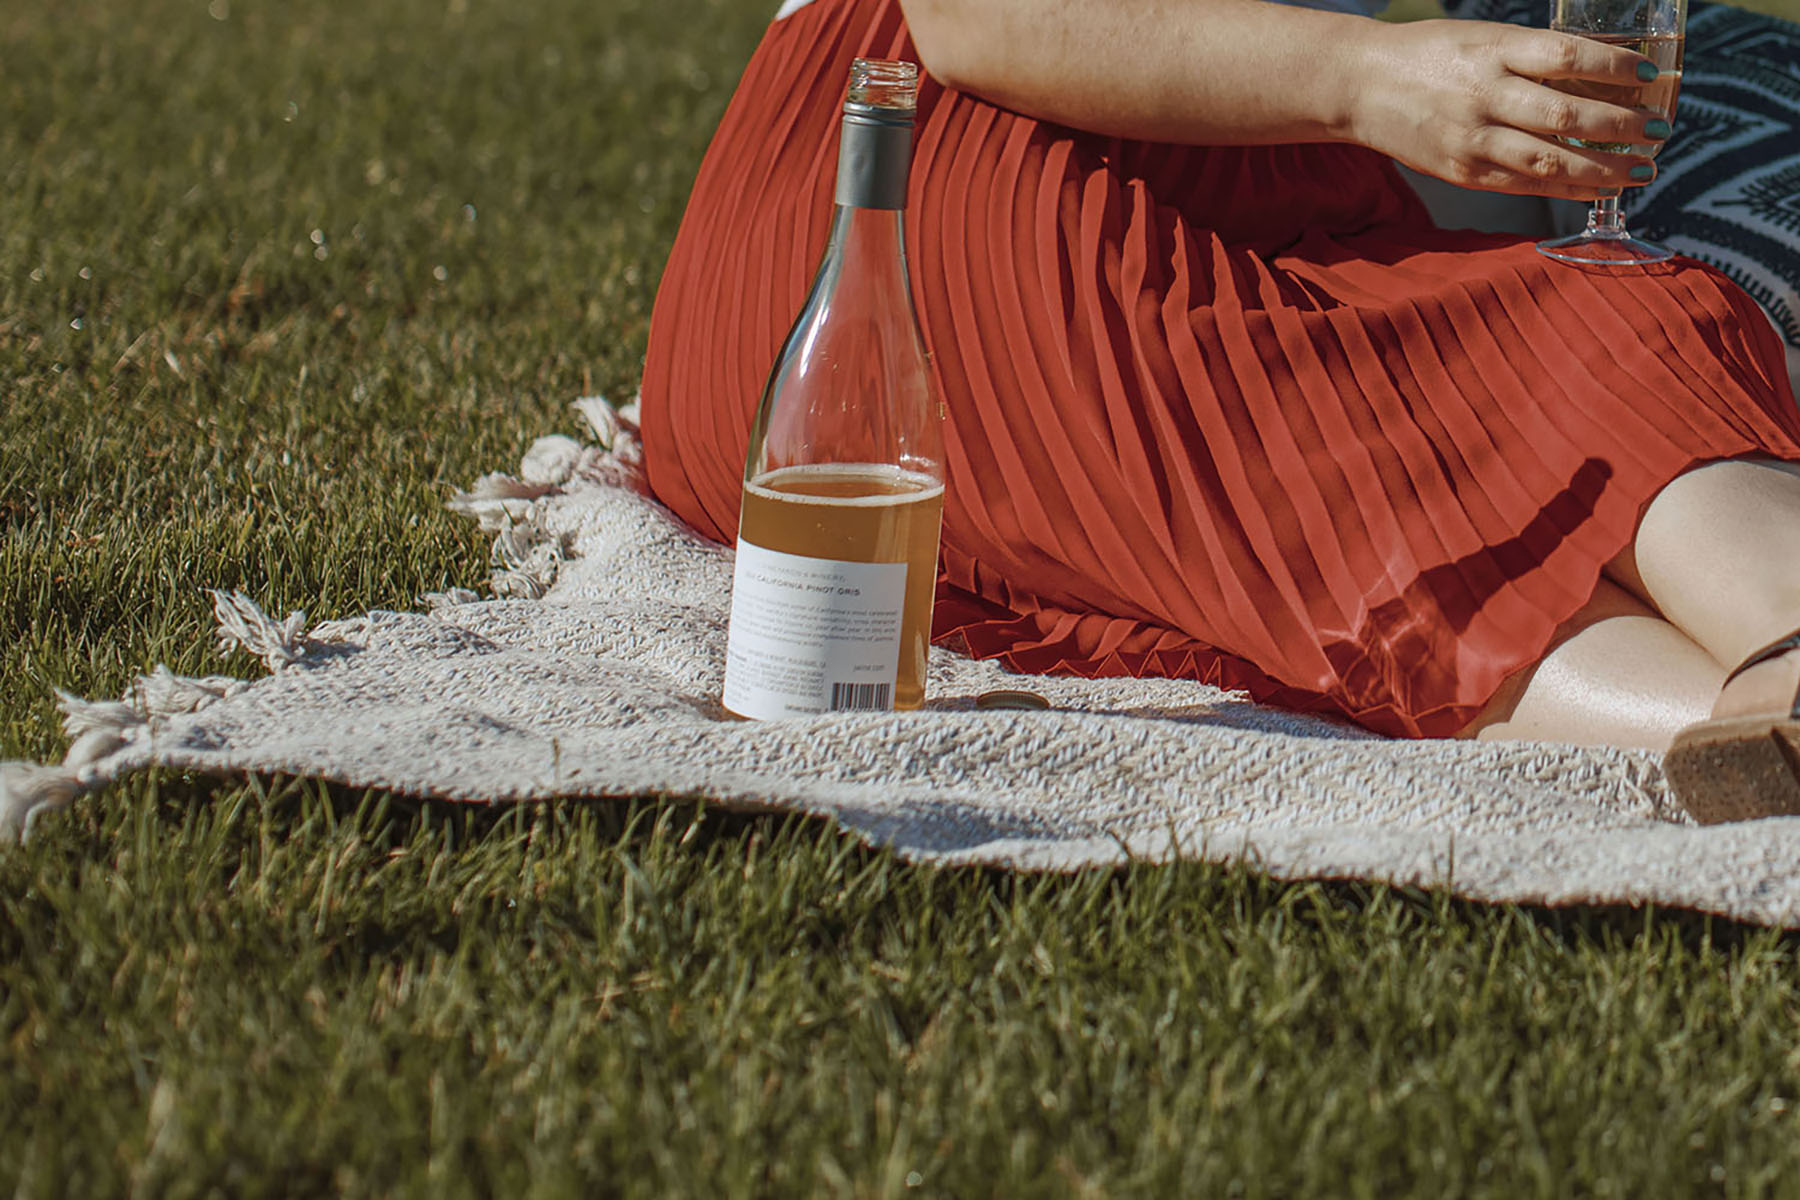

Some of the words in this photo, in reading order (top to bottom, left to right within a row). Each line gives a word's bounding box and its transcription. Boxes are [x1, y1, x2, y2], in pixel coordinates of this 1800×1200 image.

[756, 575, 803, 591] CALIFORNIA
[806, 584, 834, 595] PINOT
[837, 587, 861, 597] GRIS
